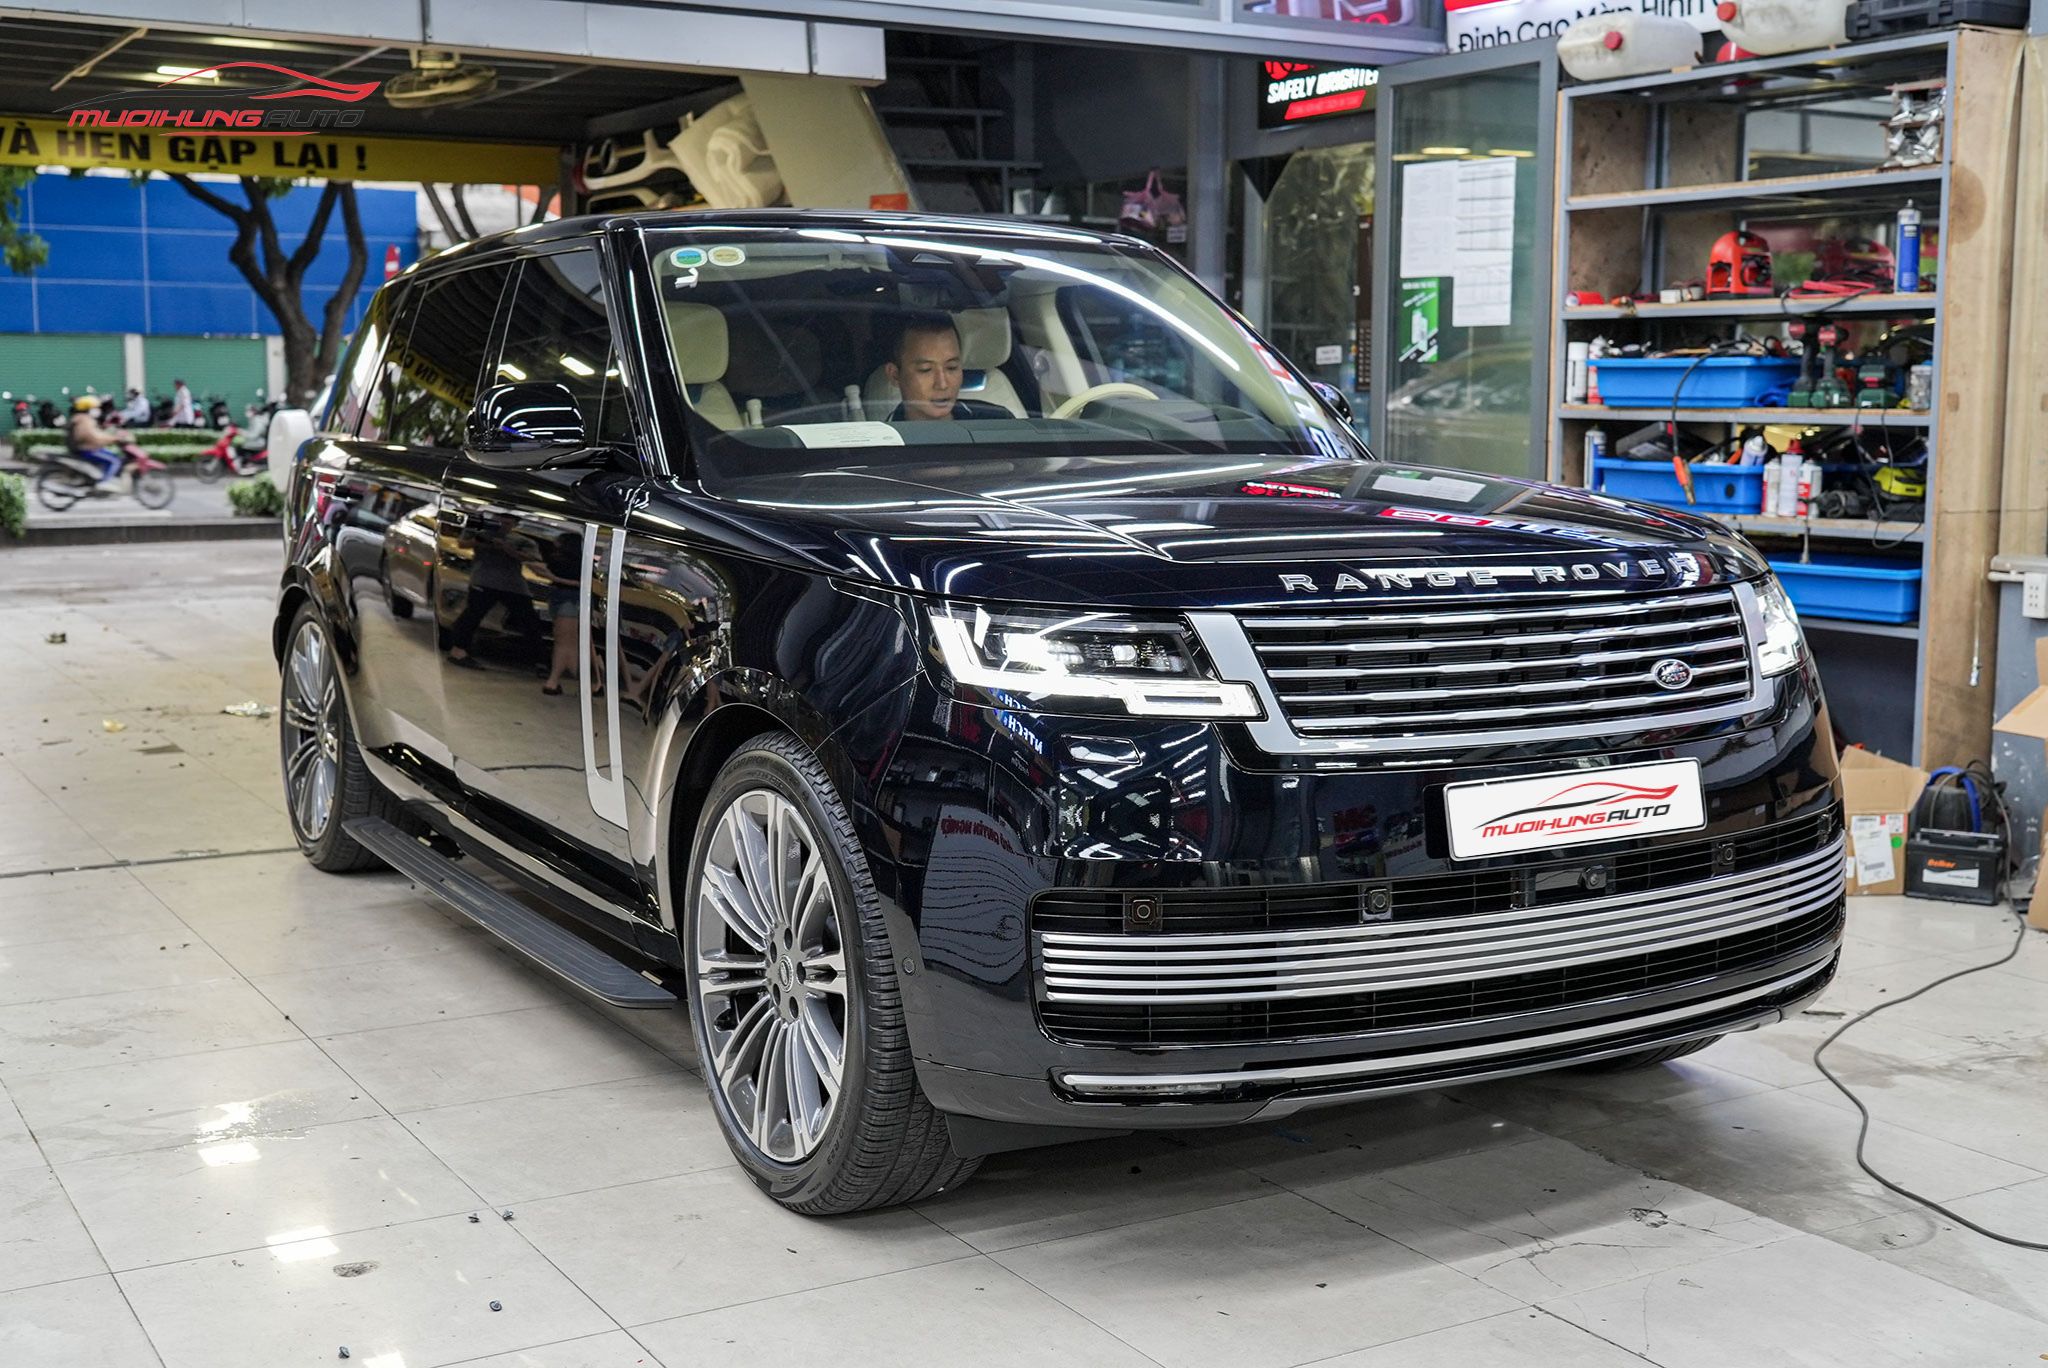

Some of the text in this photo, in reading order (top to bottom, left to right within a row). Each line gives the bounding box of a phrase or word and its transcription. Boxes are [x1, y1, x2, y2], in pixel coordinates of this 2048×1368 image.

[1267, 75, 1317, 104] SAFELY
[0, 120, 40, 156] À
[273, 140, 339, 175] LẠI
[1278, 557, 1694, 593] RANGE ROVER
